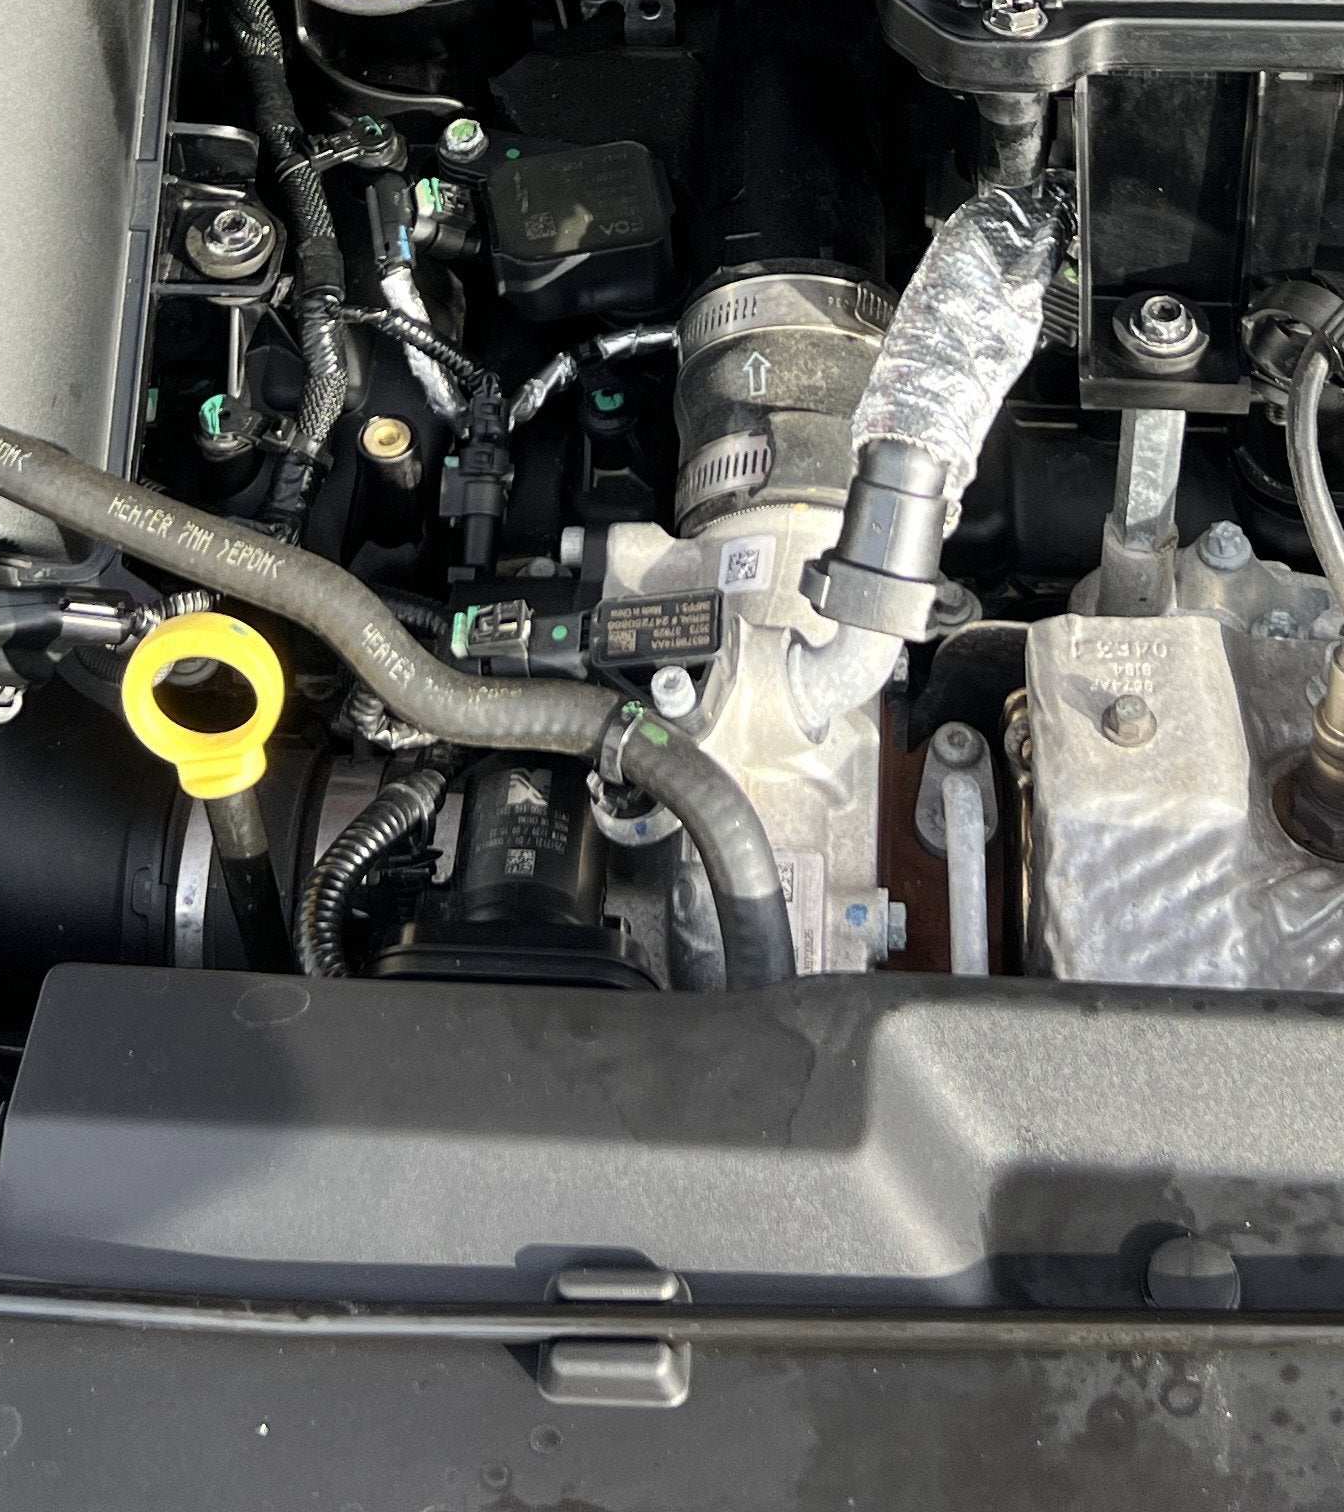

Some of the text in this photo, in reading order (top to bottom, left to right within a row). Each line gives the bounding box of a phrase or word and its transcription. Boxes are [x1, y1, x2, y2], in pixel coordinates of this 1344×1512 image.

[107, 493, 175, 538] HEATER
[177, 520, 214, 555] 7MM
[360, 622, 417, 689] HEATER
